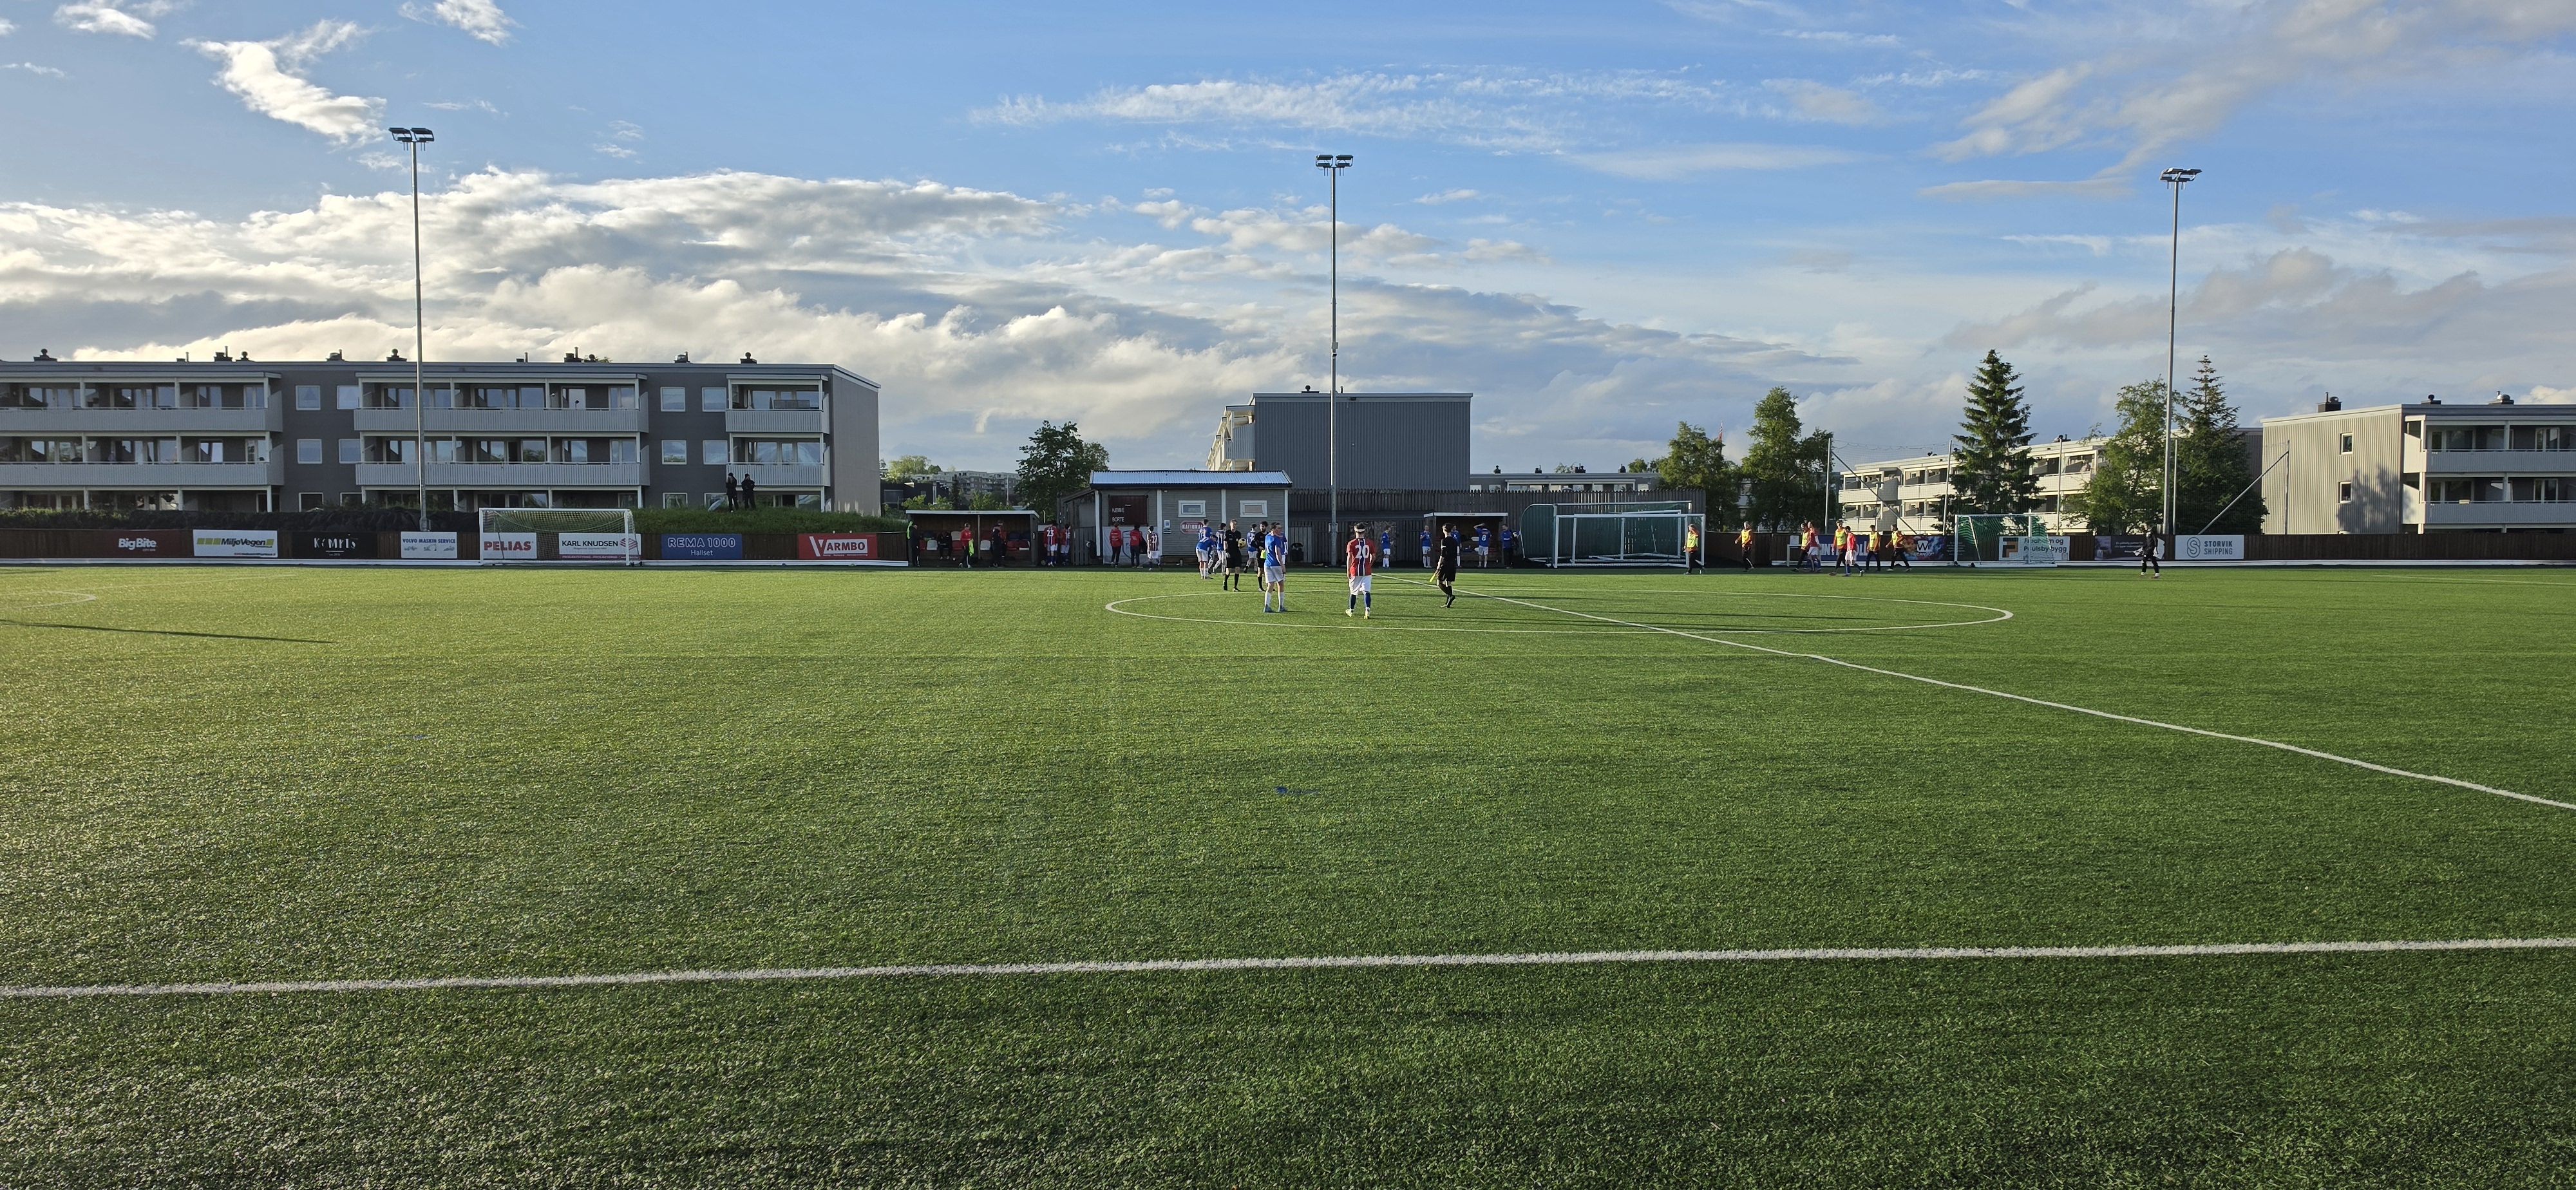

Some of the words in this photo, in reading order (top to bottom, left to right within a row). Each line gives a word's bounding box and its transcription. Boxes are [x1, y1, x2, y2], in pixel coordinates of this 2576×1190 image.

[484, 541, 531, 551] PELIAS
[668, 537, 705, 548] REMA
[707, 537, 735, 548] 1000
[809, 536, 866, 556] VARMBO
[1355, 544, 1370, 559] 20
